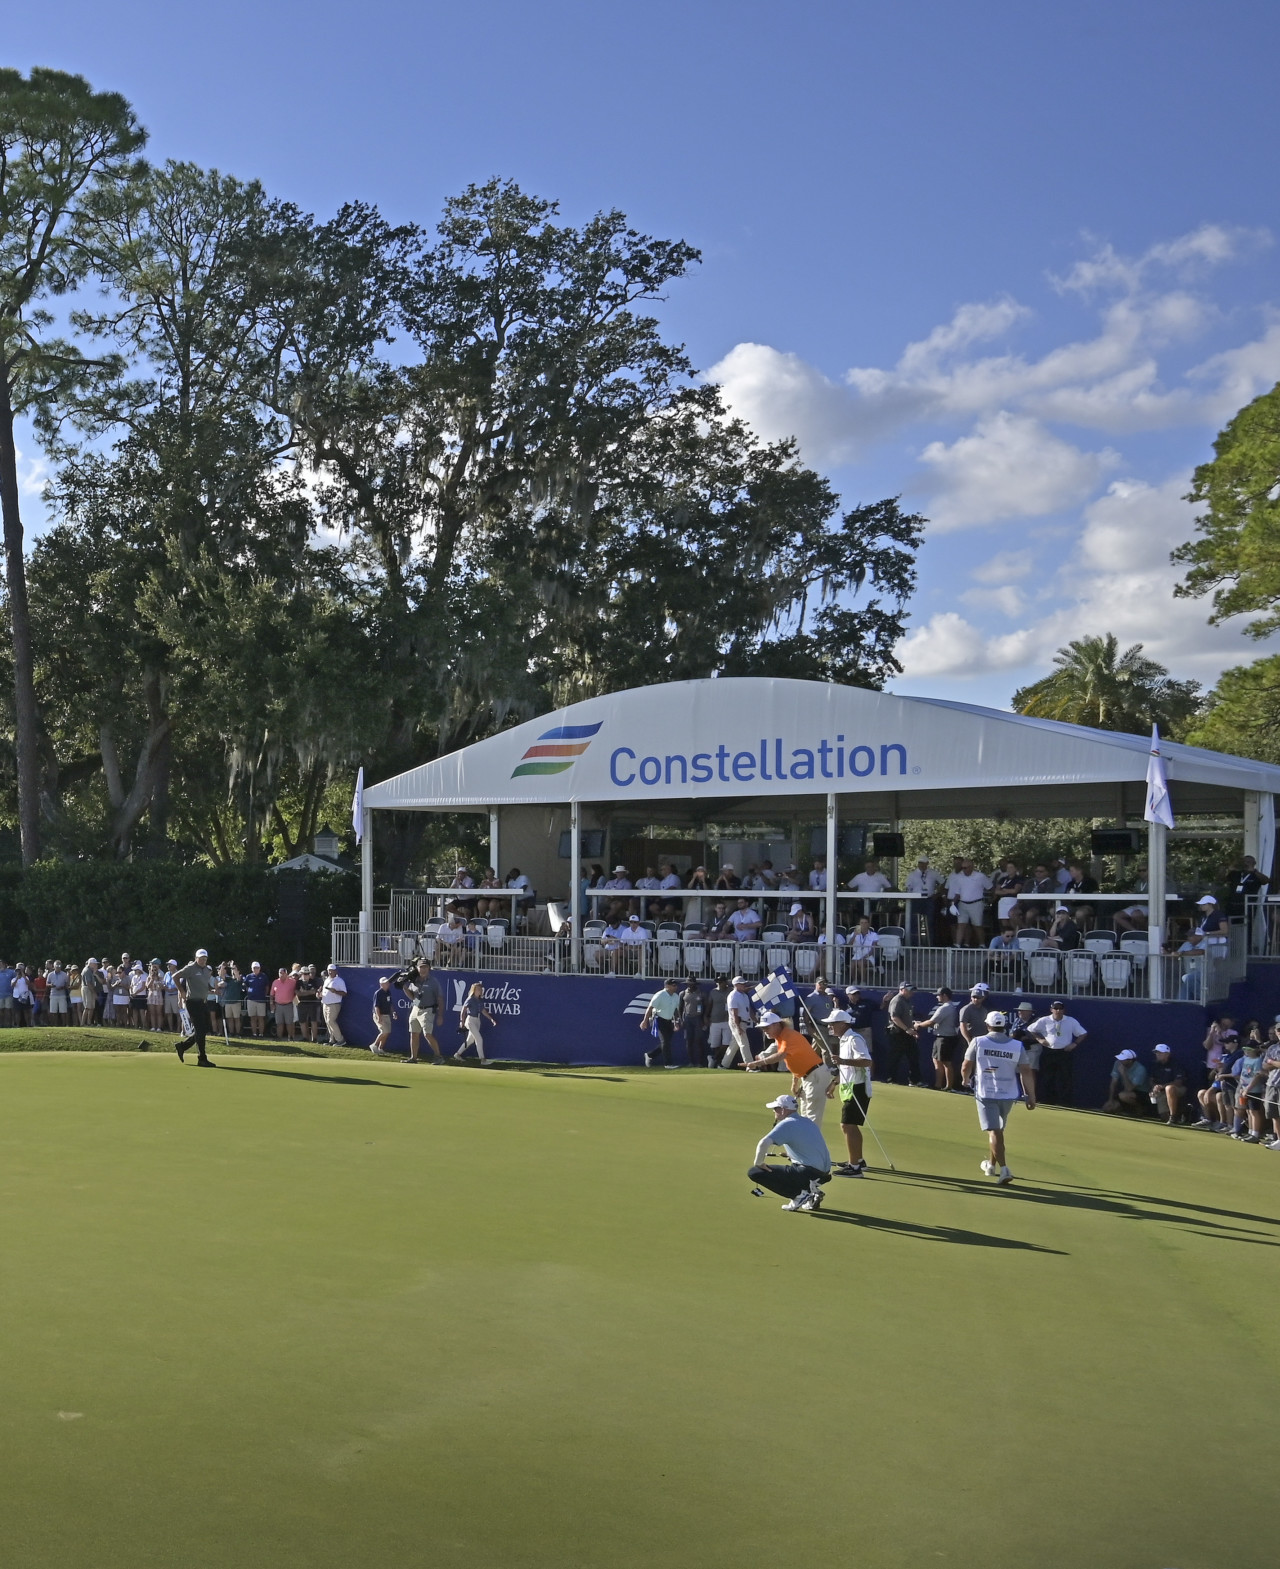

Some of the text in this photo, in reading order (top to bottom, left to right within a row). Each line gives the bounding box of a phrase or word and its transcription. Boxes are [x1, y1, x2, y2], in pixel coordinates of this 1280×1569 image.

[610, 734, 908, 787] Constellation
[478, 980, 522, 1001] harles
[483, 1002, 521, 1015] HWAB
[983, 1049, 1014, 1060] MICKELSON
